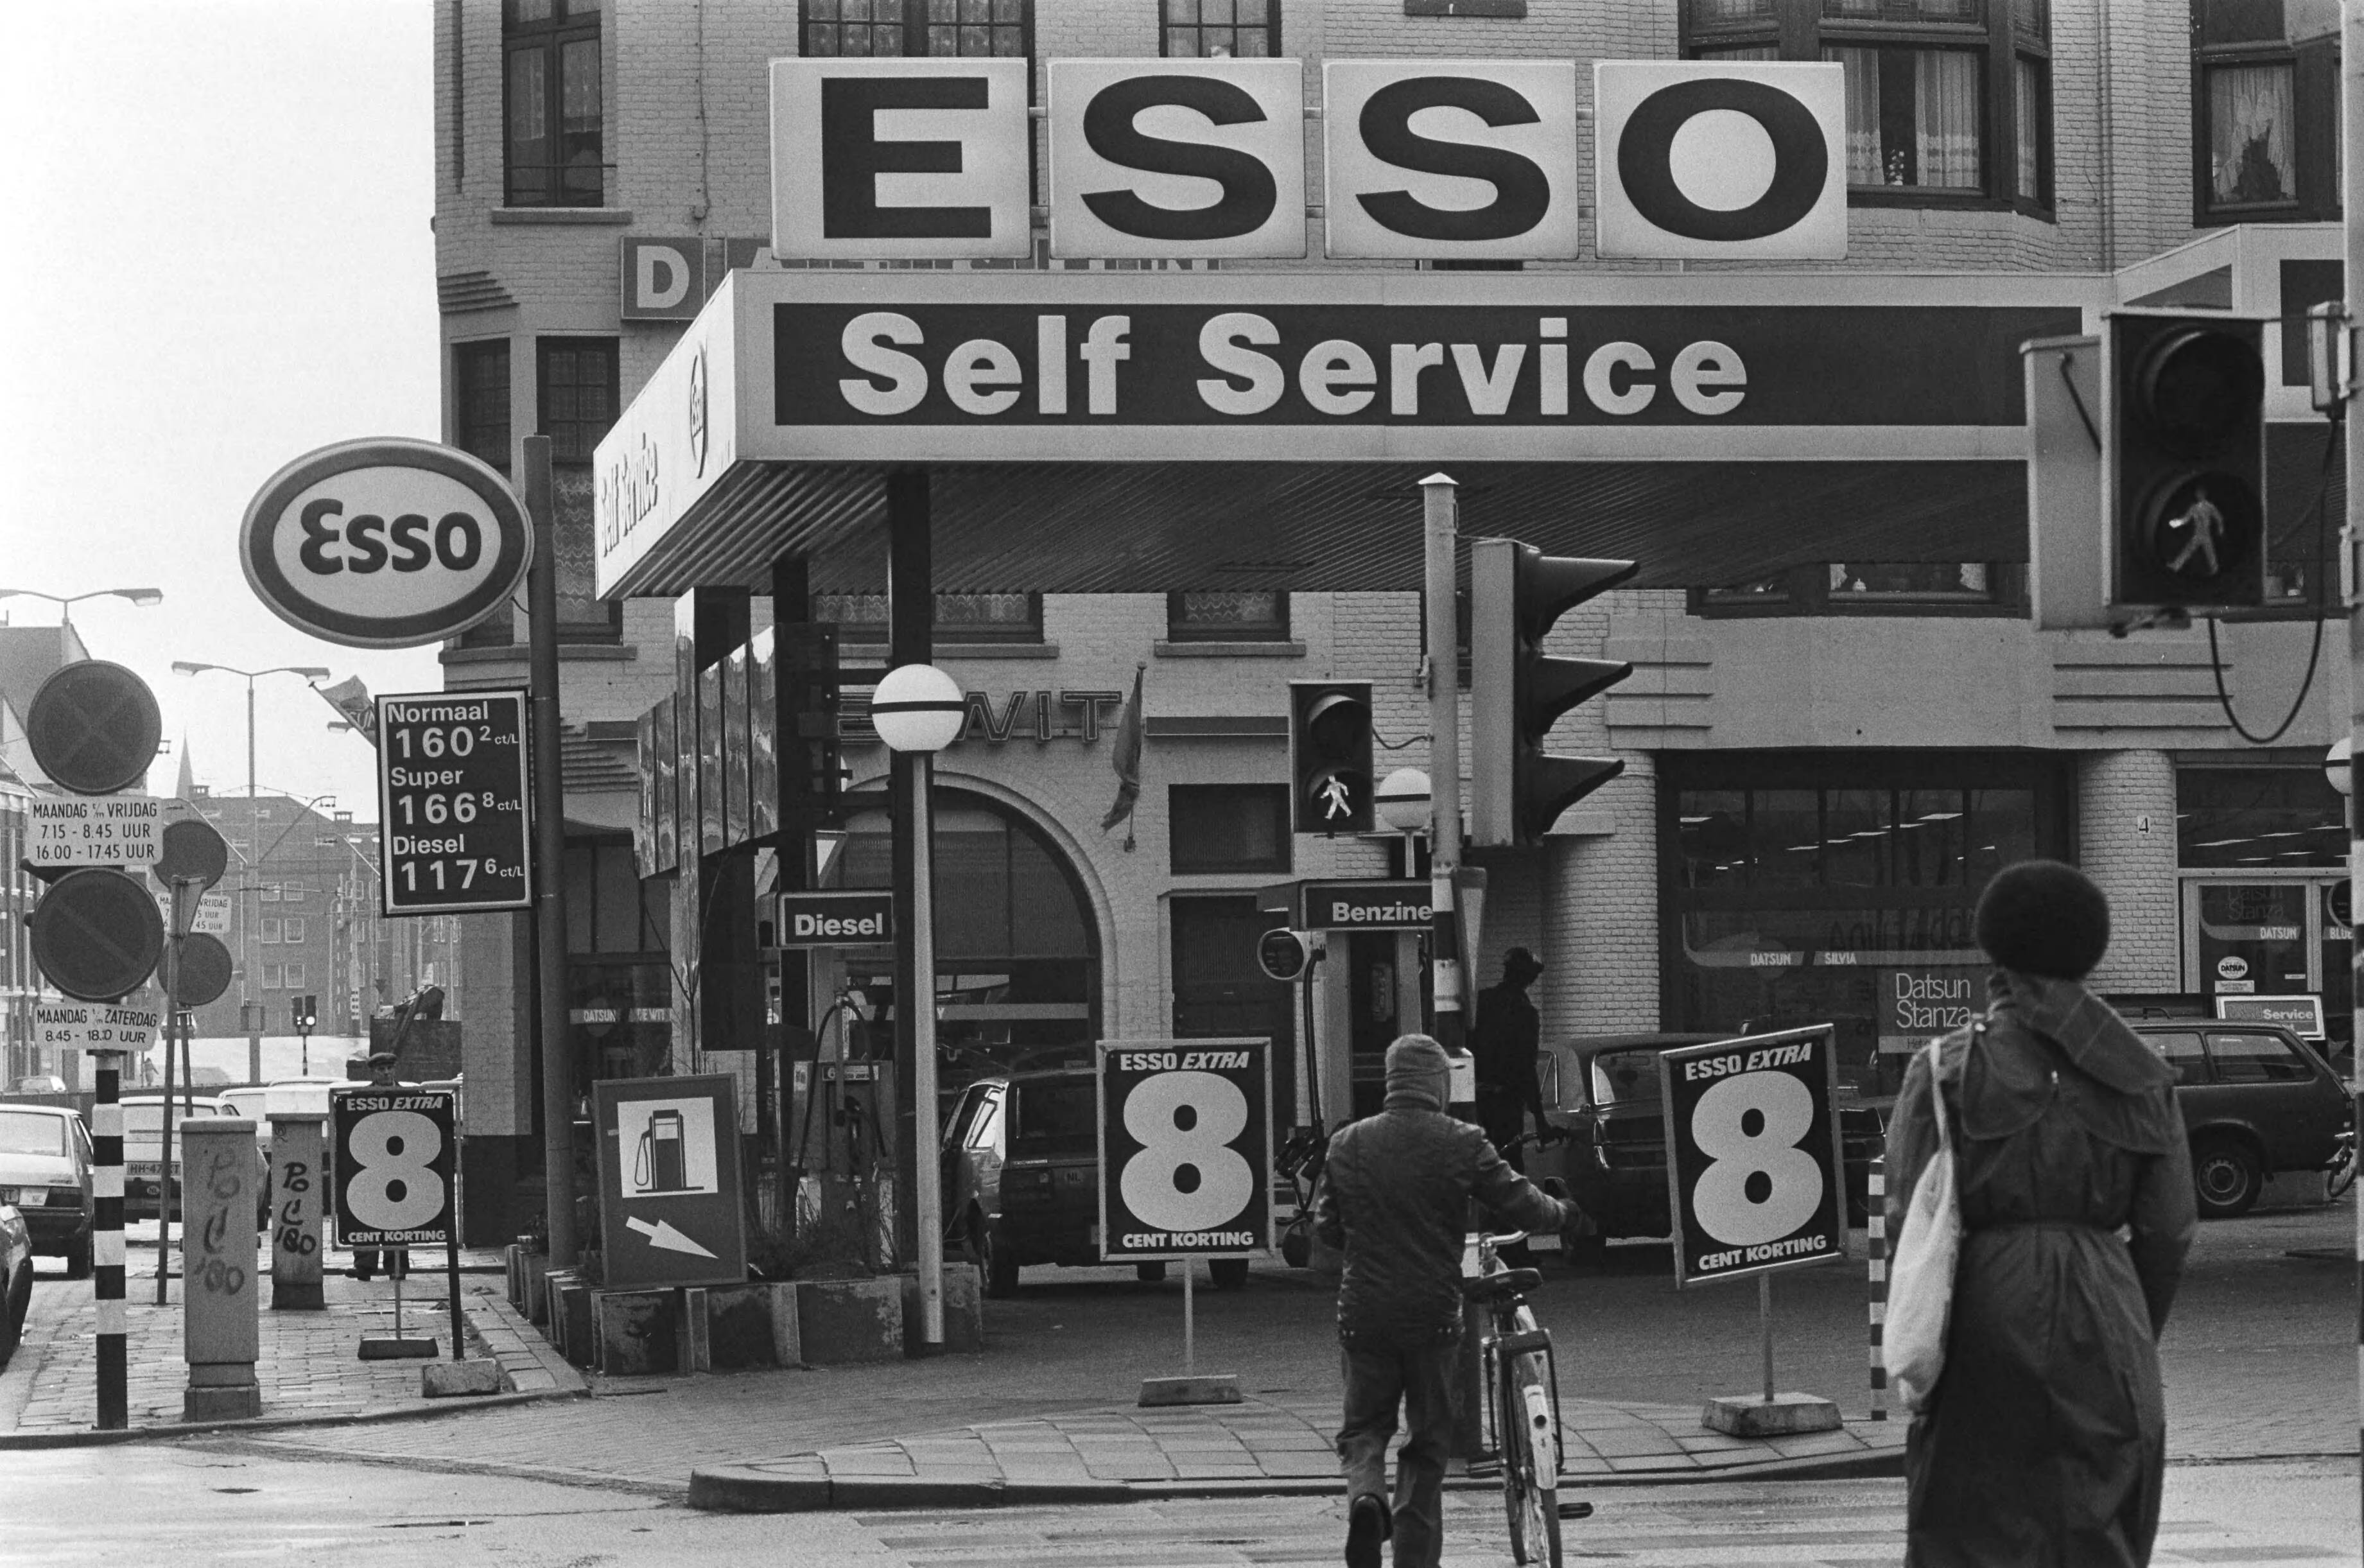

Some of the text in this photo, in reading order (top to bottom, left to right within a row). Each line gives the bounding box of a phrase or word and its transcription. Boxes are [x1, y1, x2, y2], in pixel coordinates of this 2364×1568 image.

[821, 74, 1829, 243] ESSO
[838, 312, 1749, 416] Self Service
[388, 701, 488, 723] Normaal
[391, 767, 464, 788] Super
[33, 804, 87, 818] MAANDAG
[107, 803, 157, 817] VRIJDAG
[40, 824, 65, 839] 7.15
[83, 824, 112, 839] 8.45
[123, 824, 150, 838] UUR
[2139, 817, 2149, 833] 4
[36, 845, 71, 859] 16.00
[126, 844, 155, 858] UUR
[393, 833, 465, 855] Diesel
[1332, 902, 1434, 922] Benzine
[794, 914, 883, 936] Diesel
[2259, 927, 2298, 939] DATSUN
[1750, 952, 1857, 966] DATSUN SILVIA
[1896, 973, 1970, 999] Datsun
[37, 1009, 87, 1024] MAANDAG
[104, 1009, 157, 1027] ZATERDAG
[1896, 1000, 1971, 1028] Stanza
[2263, 1008, 2314, 1020] Service
[46, 1030, 71, 1041] 8.45
[119, 1031, 146, 1043] UUR
[1120, 1051, 1250, 1071] ESSO EXTRA
[1685, 1042, 1812, 1081] ESSO EXTRA
[347, 1096, 444, 1111] ESSO EXTRA
[1120, 1071, 1253, 1232] 8
[1691, 1070, 1823, 1246] 8
[347, 1111, 445, 1231] 8
[347, 1230, 446, 1242] CENT KORTING
[1122, 1232, 1254, 1248] CENT KORTING
[1699, 1235, 1827, 1271] CENT KORTING
